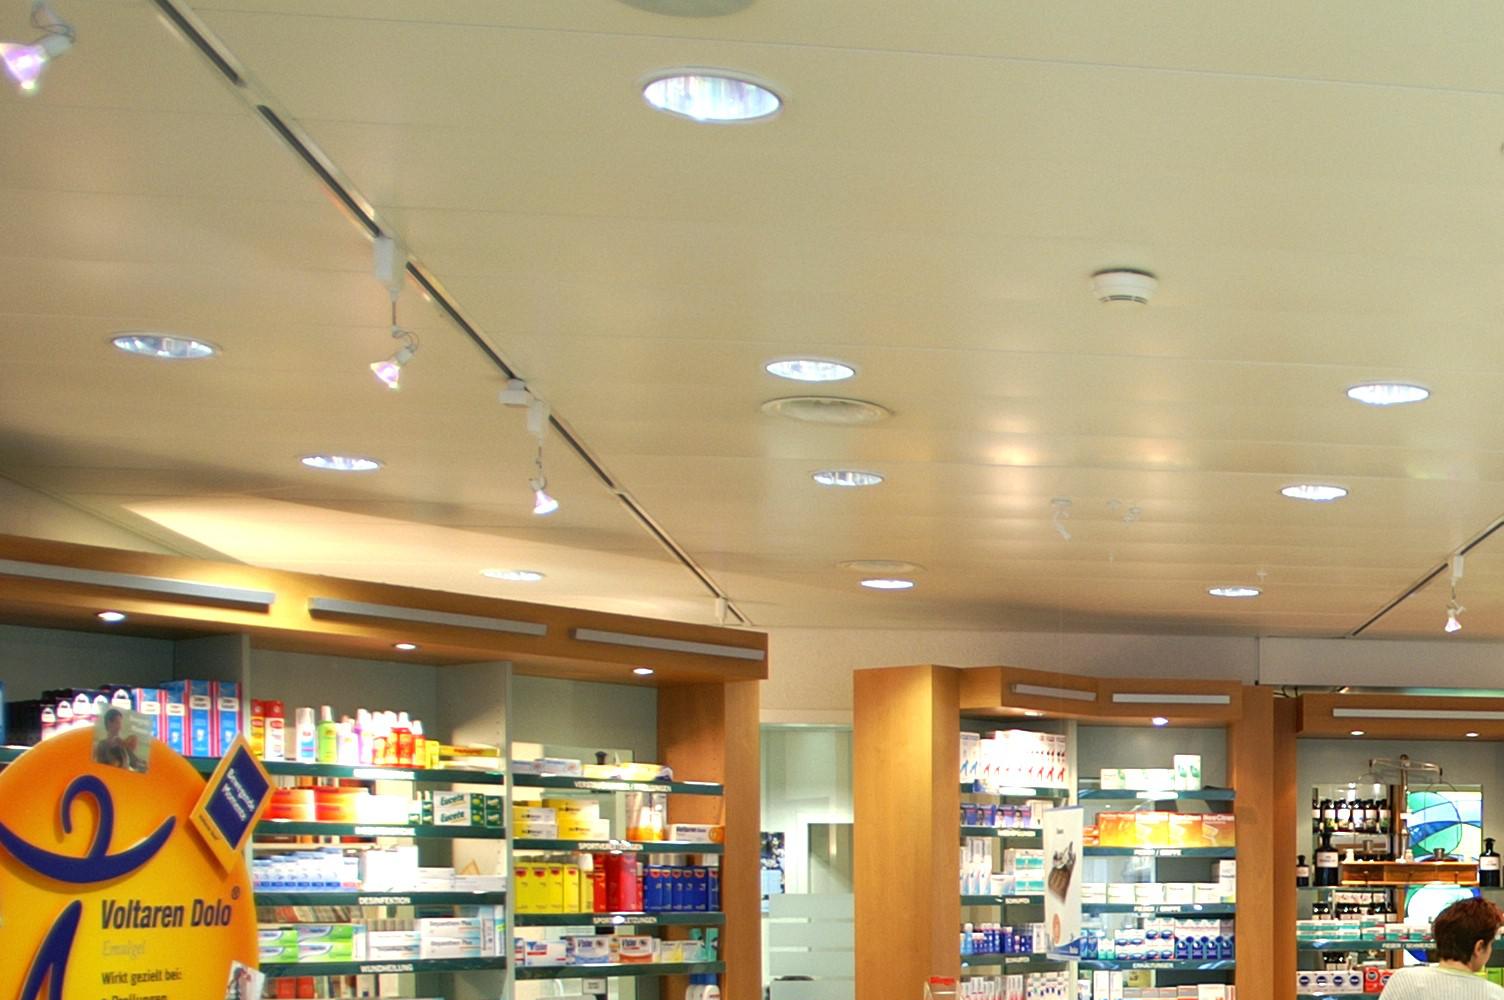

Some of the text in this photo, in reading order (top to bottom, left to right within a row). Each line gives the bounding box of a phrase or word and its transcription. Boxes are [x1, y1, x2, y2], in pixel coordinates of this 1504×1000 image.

[101, 898, 232, 929] Voltaren Dolo
[101, 970, 128, 985] Wirkt
[131, 968, 162, 986] gezielt
